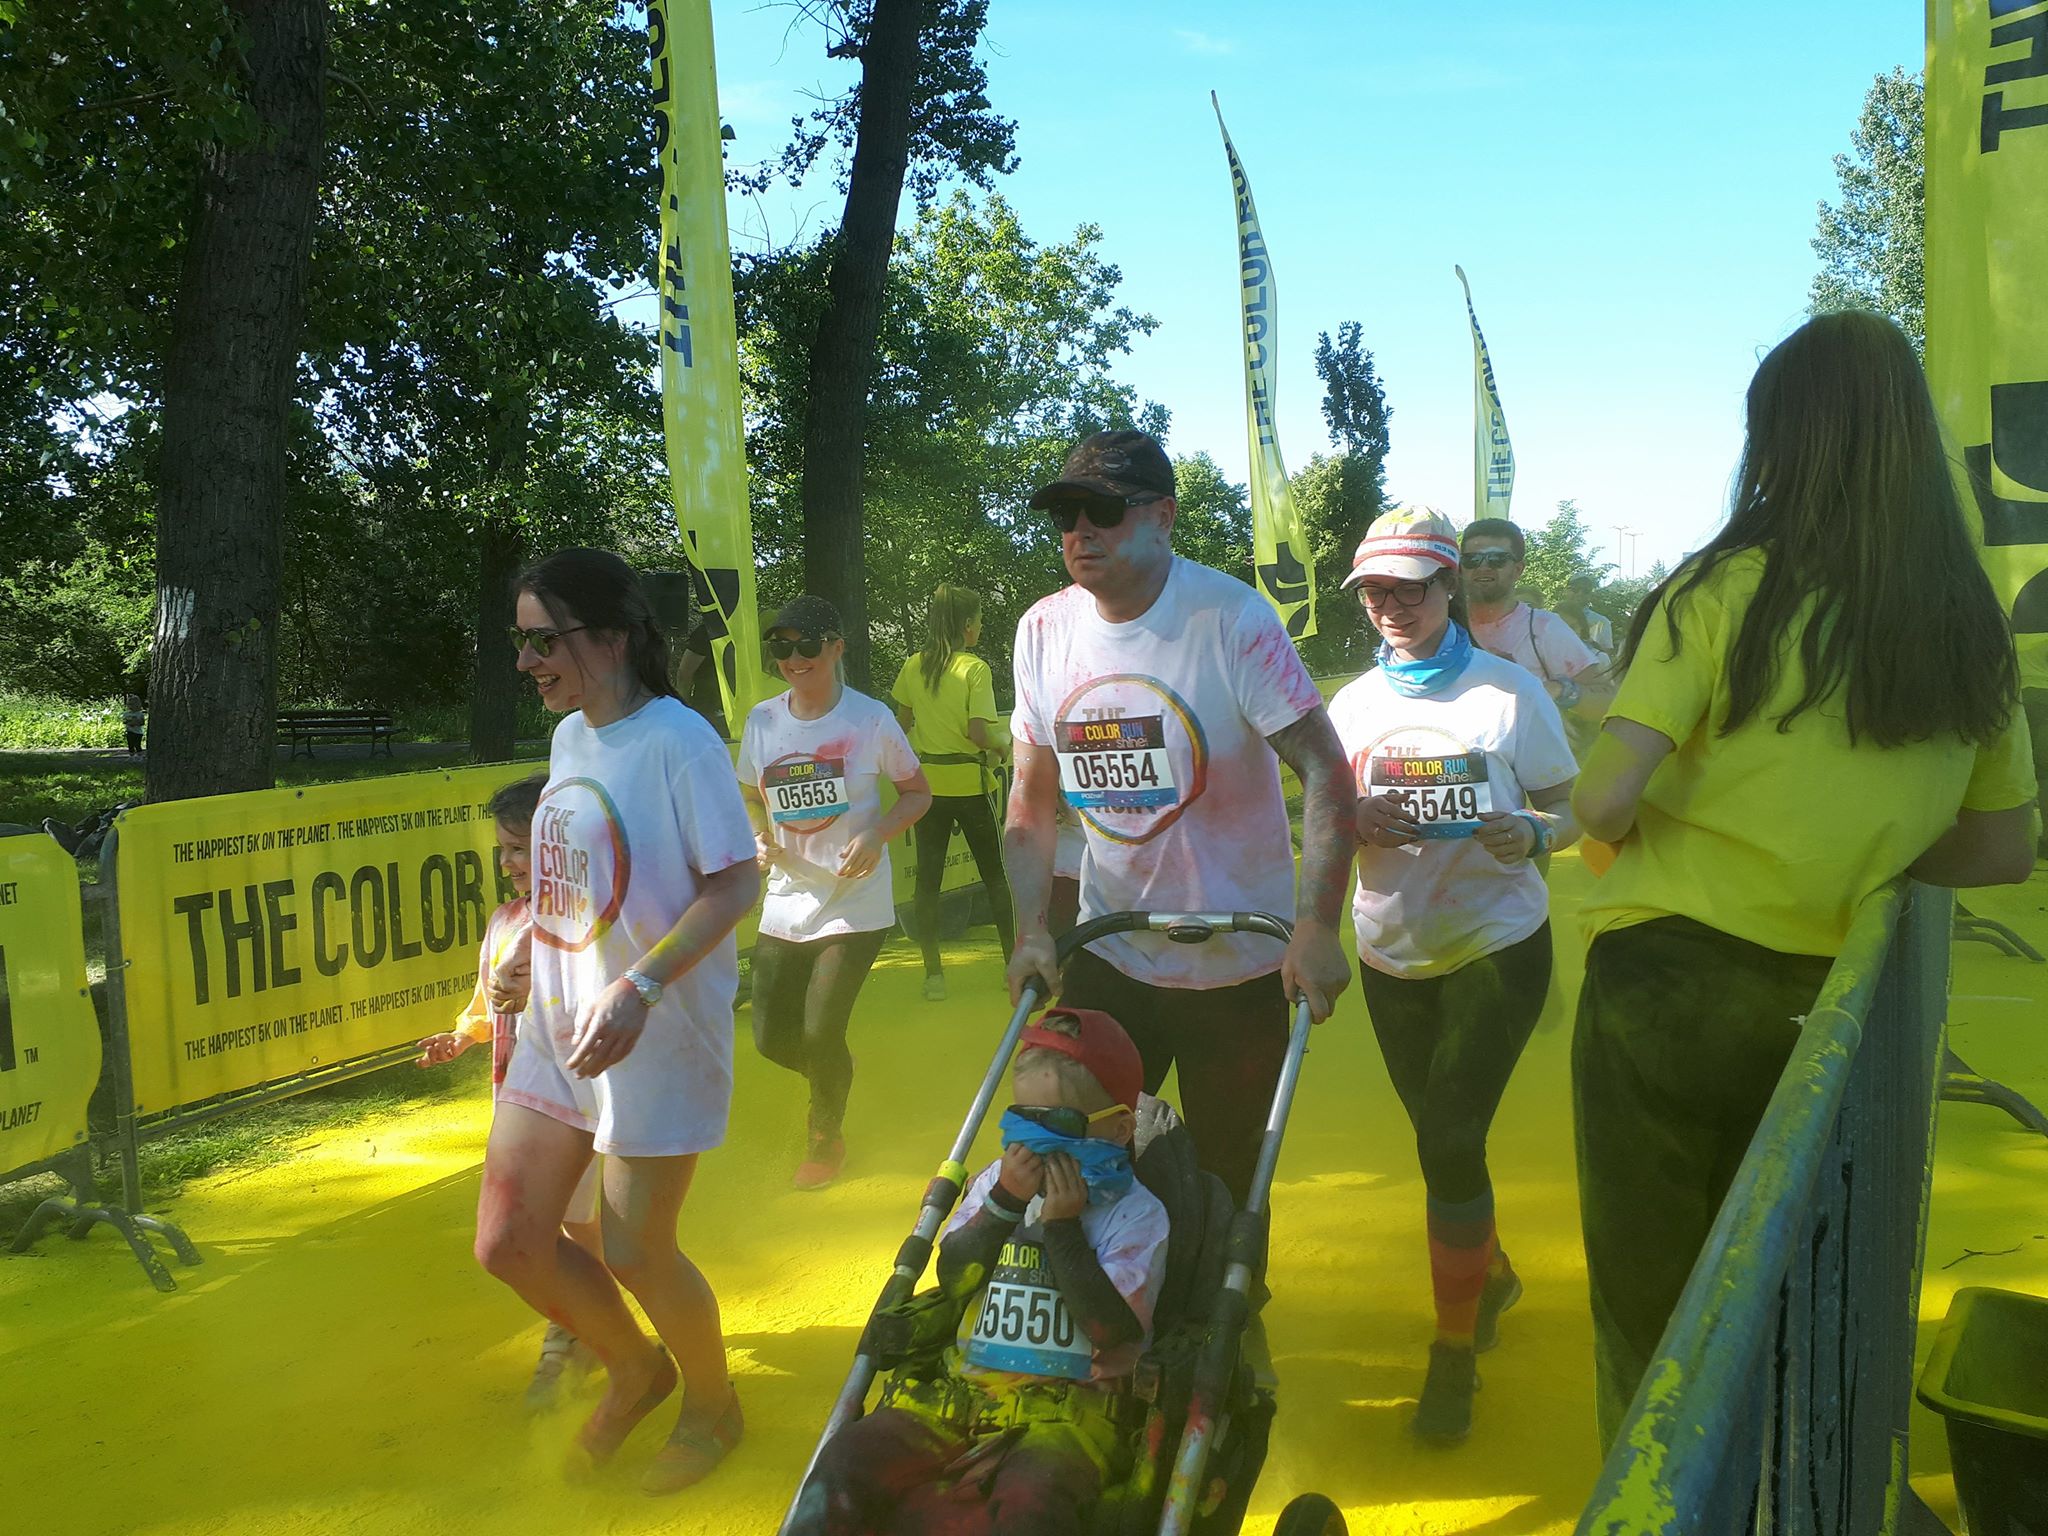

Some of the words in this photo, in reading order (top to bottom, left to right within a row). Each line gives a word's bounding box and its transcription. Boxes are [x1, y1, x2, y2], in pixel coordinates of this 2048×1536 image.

[1487, 450, 1512, 502] THE
[1085, 723, 1120, 740] COLOR
[1120, 721, 1144, 737] RUN
[789, 763, 815, 777] COLOR
[1072, 752, 1159, 789] 05554
[1384, 761, 1404, 776] THE
[1404, 760, 1443, 776] COLOR
[1444, 758, 1468, 774] RUN
[1436, 772, 1469, 784] shine
[777, 780, 838, 810] 05553
[1386, 786, 1478, 822] 5549
[173, 842, 194, 863] THE
[197, 835, 245, 860] HAPPIEST
[247, 833, 260, 853] 5K
[262, 831, 275, 851] ON
[277, 828, 294, 848] THE
[296, 823, 330, 846] PLANET
[337, 820, 355, 839] THE
[356, 815, 400, 837] HAPPIEST
[401, 812, 413, 831] 5K
[415, 811, 425, 828] ON
[426, 809, 442, 827] THE
[444, 805, 471, 824] PLANET
[540, 805, 576, 845] THE
[539, 842, 589, 888] COLOR
[537, 879, 579, 922] RUN
[173, 879, 302, 1006] THE
[311, 850, 487, 977] COLOR
[184, 1038, 206, 1061] THE
[208, 1026, 256, 1055] HAPPIEST
[258, 1022, 272, 1042] 5K
[274, 1019, 287, 1038] ON
[289, 1014, 308, 1034] THE
[310, 1005, 343, 1030] PLANET
[350, 999, 367, 1019] THE
[369, 989, 409, 1015] HAPPIEST
[411, 986, 422, 1004] 5K
[424, 983, 435, 1001] ON
[436, 978, 452, 997] THE
[24, 1047, 39, 1064] TM
[974, 1286, 1074, 1348] 5550
